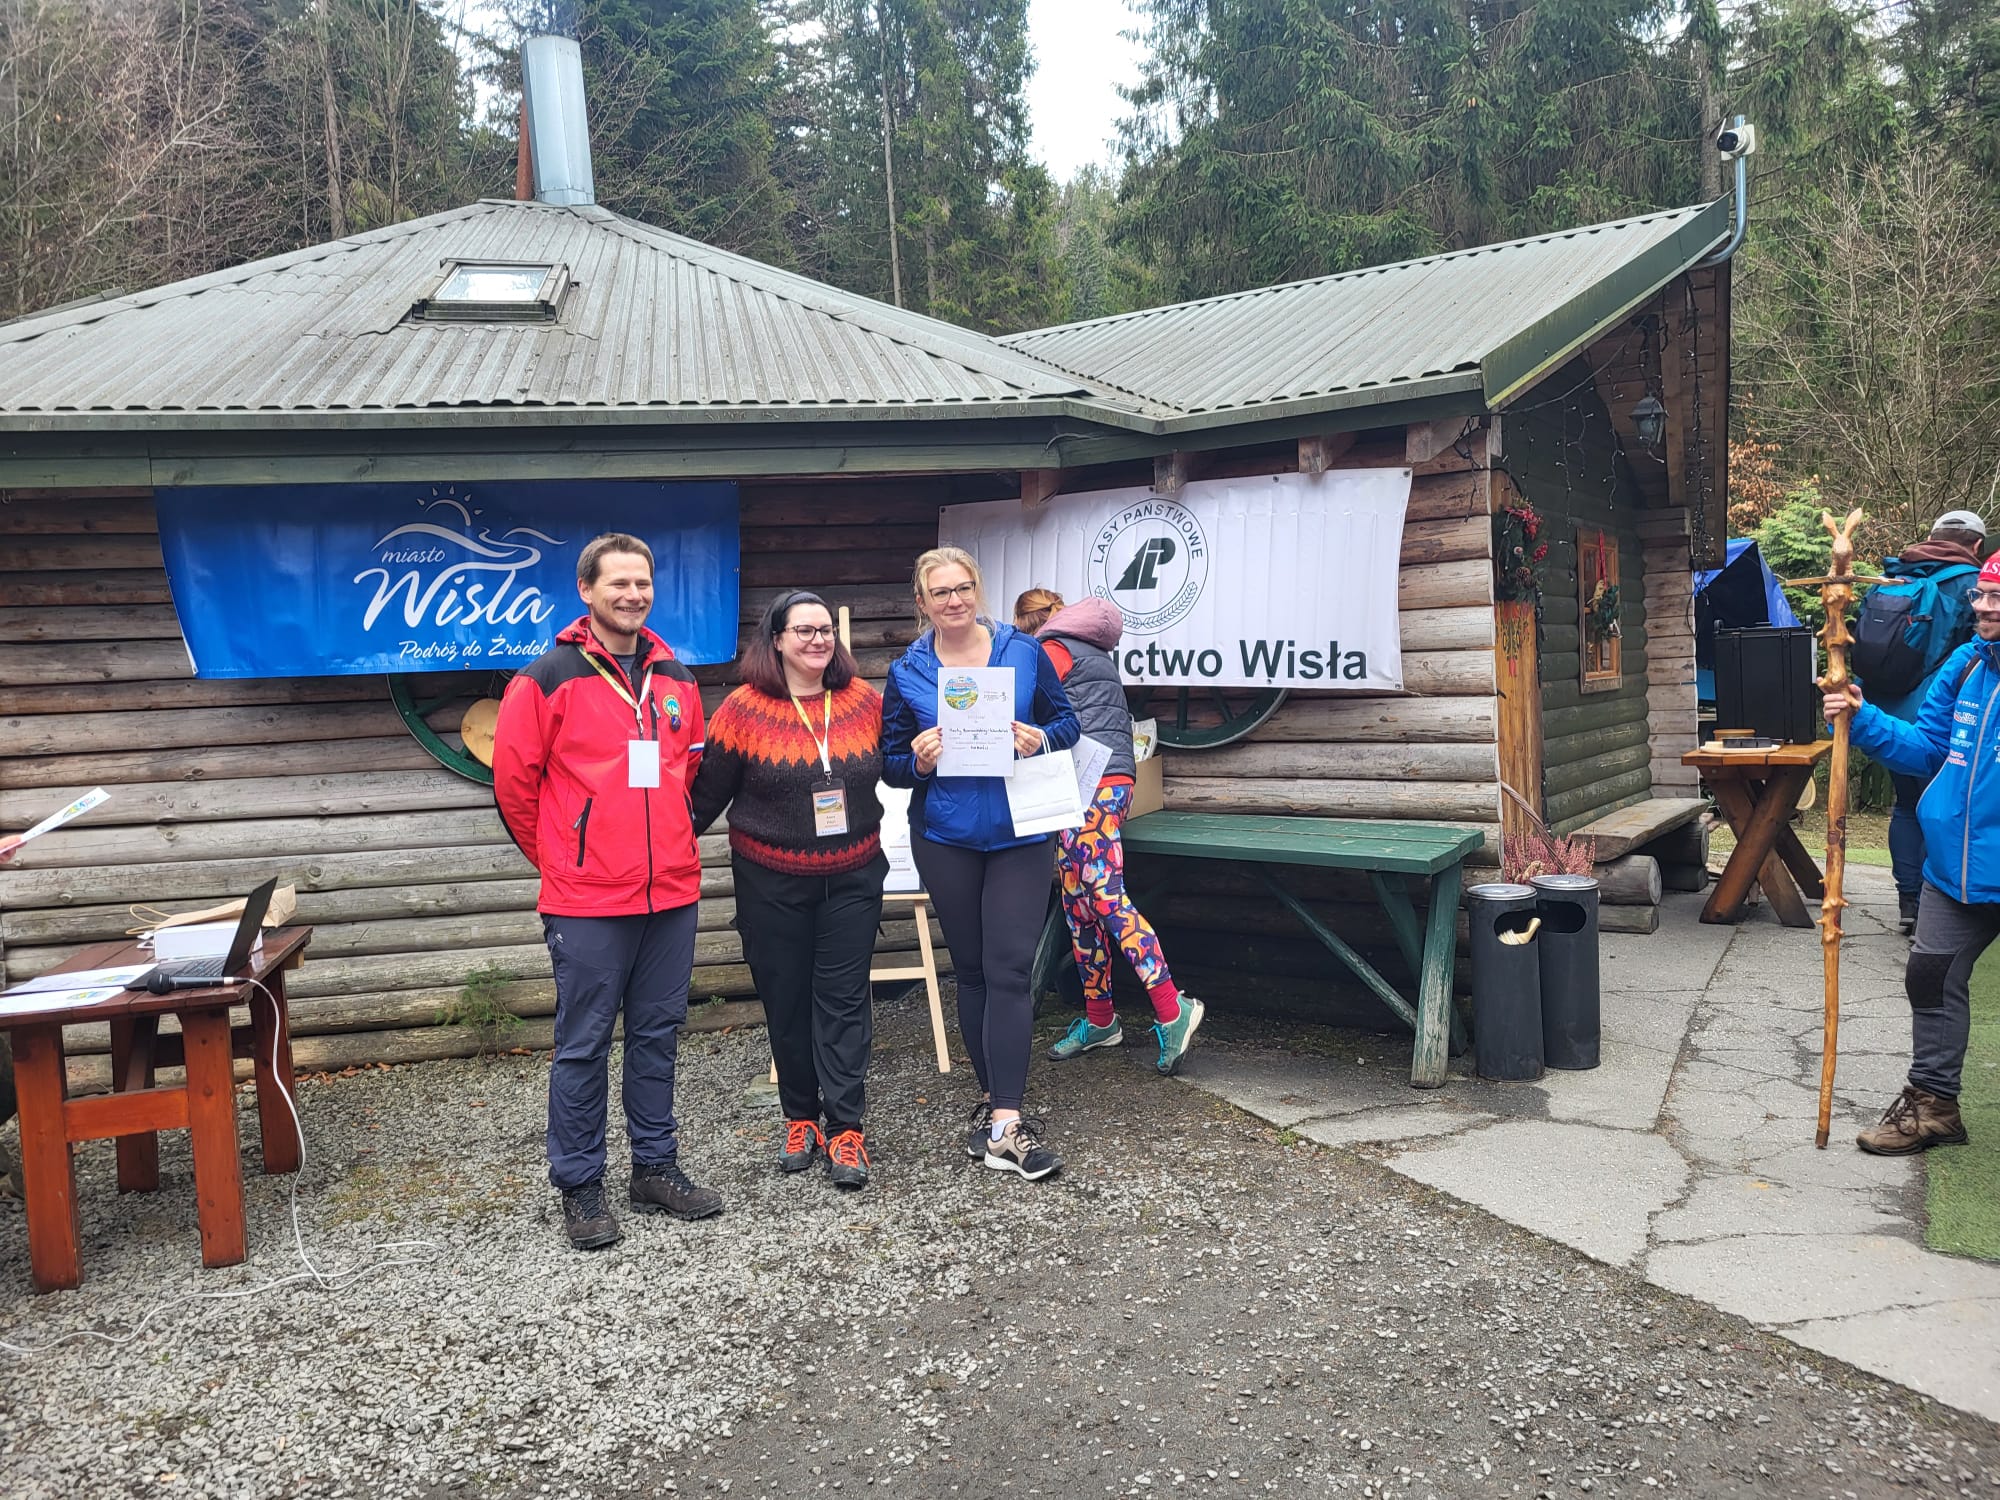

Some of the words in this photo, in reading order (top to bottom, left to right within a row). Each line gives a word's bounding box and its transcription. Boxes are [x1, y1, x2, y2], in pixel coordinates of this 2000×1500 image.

[1094, 521, 1120, 563] LASY
[1123, 502, 1203, 560] PAŃSTWOWE
[382, 546, 445, 564] miasto
[399, 640, 459, 662] Podróż
[462, 640, 482, 656] do
[488, 633, 549, 656] Źródeł
[1113, 640, 1223, 677] ictwo
[1239, 639, 1367, 679] Wisła
